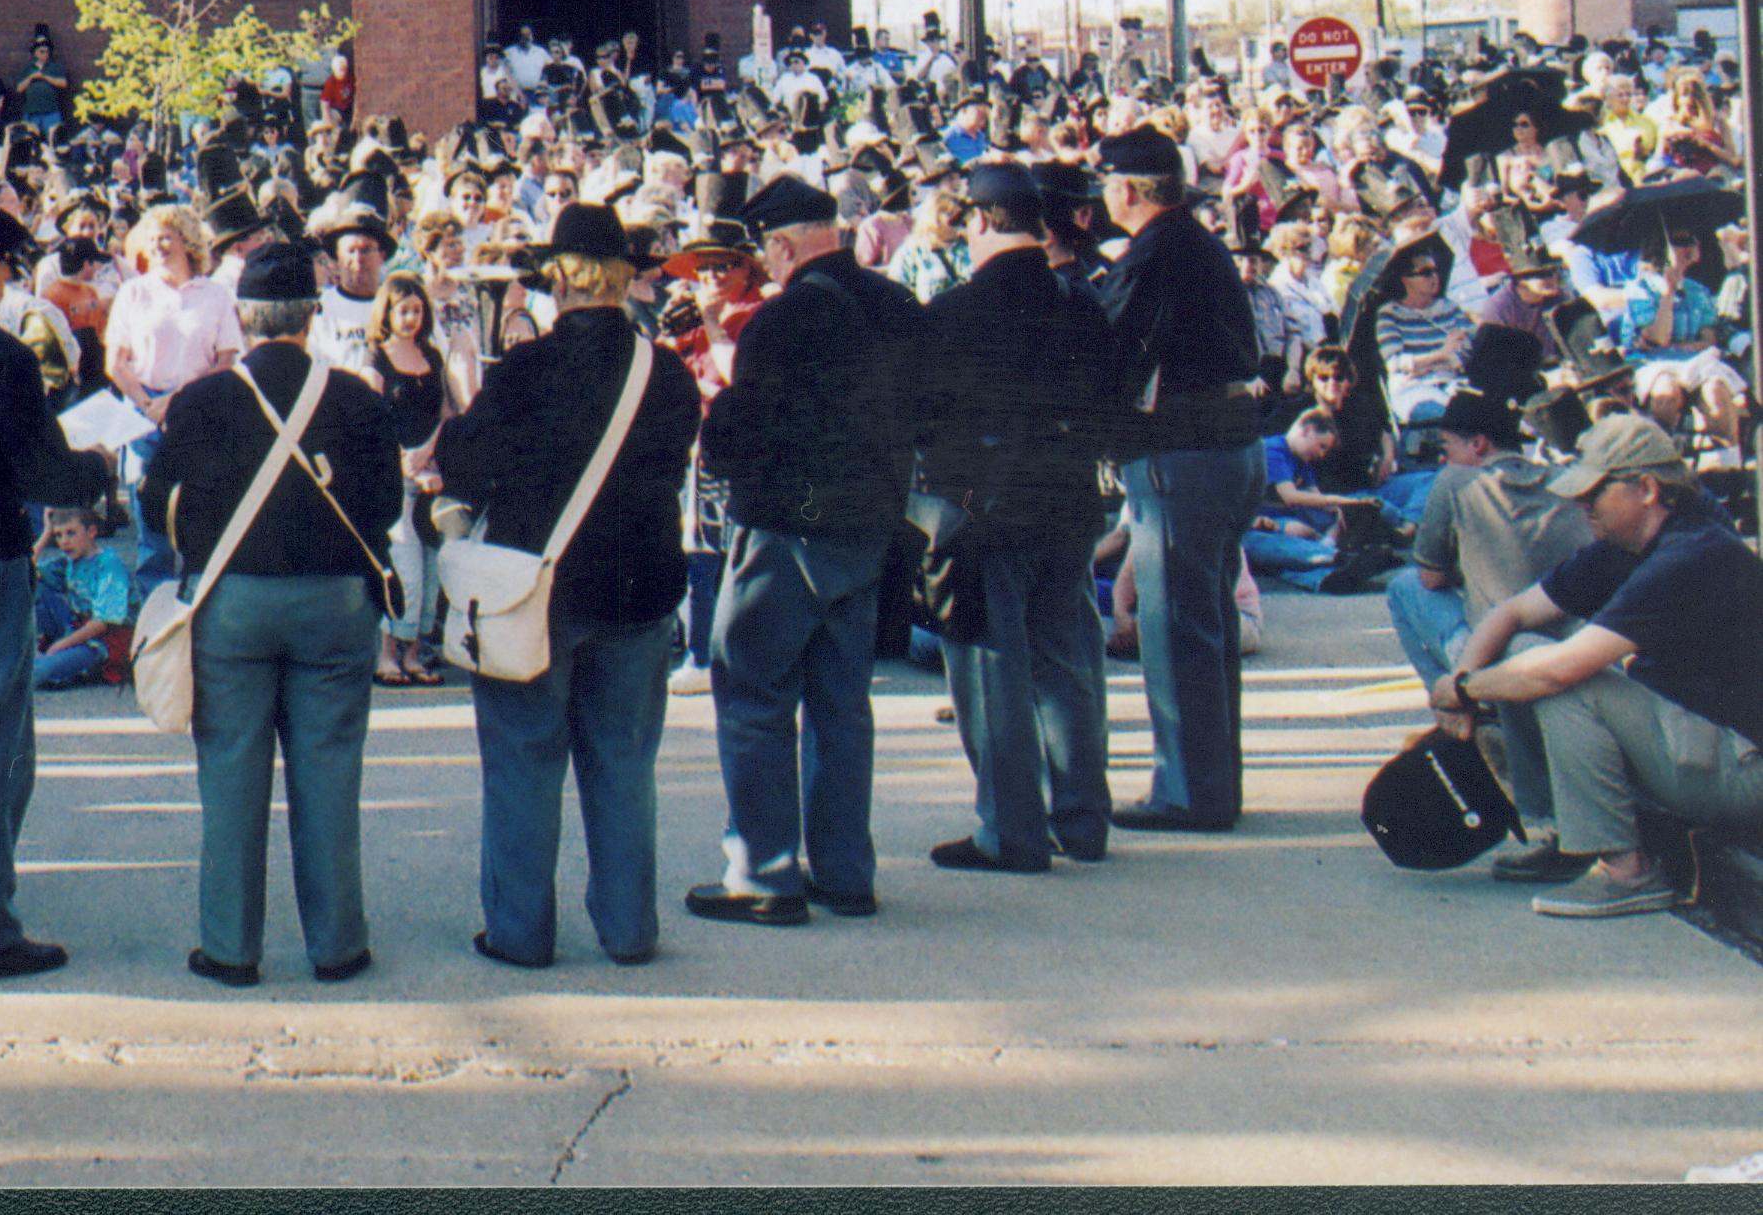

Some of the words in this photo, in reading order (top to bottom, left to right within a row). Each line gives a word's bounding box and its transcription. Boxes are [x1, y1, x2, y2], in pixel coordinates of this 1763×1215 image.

[1298, 32, 1317, 44] DO
[1322, 29, 1348, 42] NOT
[1306, 62, 1347, 75] ENTER
